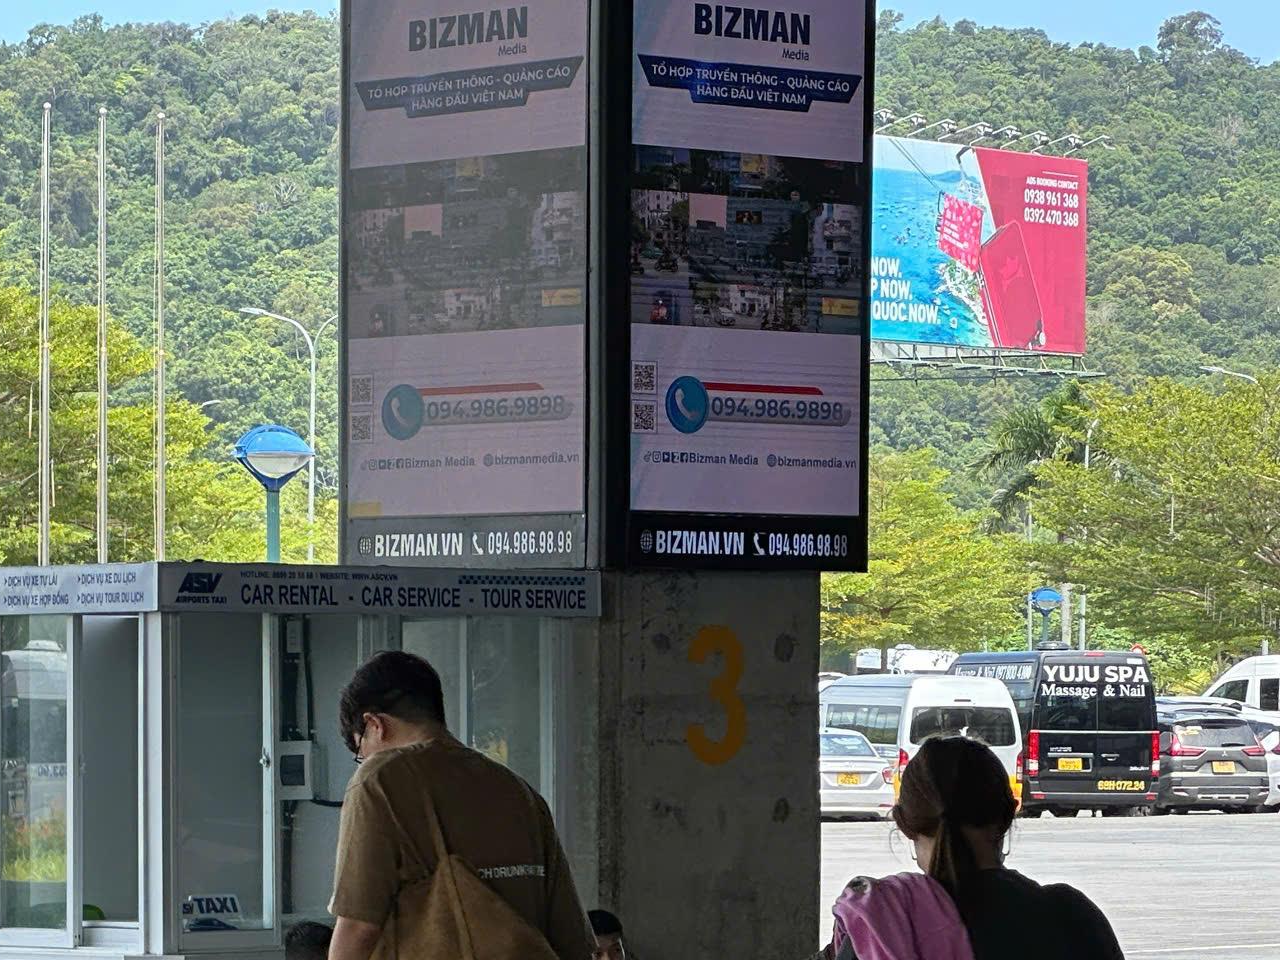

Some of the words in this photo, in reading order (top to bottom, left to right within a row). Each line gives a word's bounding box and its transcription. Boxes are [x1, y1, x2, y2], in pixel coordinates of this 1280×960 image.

[409, 6, 528, 51] BIZMAN
[694, 3, 811, 45] BIZMAN
[498, 44, 527, 56] Media
[782, 48, 810, 61] Media
[547, 65, 570, 79] CÁO
[740, 71, 778, 86] THÔNG
[828, 78, 850, 93] CÁO
[498, 88, 524, 101] NAM
[782, 91, 806, 106] NAM
[1024, 188, 1045, 205] 0938
[1046, 190, 1062, 206] 961
[1063, 192, 1079, 209] 368
[1024, 206, 1045, 223] 0392
[1045, 209, 1062, 226] 470
[1063, 211, 1079, 228] 368
[880, 279, 913, 301] NOW.
[908, 303, 941, 324] NOW.
[427, 395, 564, 420] 094.986.9898
[711, 396, 844, 421] 094.986.9898
[405, 458, 442, 469] Bizman
[445, 455, 475, 469] Media
[495, 452, 580, 467] bizmanmedia.vn
[689, 453, 726, 465] Bizman
[729, 454, 759, 466] Media
[778, 456, 857, 469] bizmanmedia.vn
[374, 533, 463, 557] BIZMAN.VN
[488, 530, 572, 555] 094.986.98.98
[656, 530, 745, 556] BIZMAN.VN
[769, 532, 848, 557] 094.986.98.98
[241, 584, 274, 606] CAR
[279, 584, 339, 606] RENTAL
[361, 586, 393, 607] CAR
[397, 587, 461, 608] SERVICE
[481, 588, 520, 609] TOUR
[525, 588, 586, 610] SERVICE
[1043, 665, 1100, 683] YUJU
[1105, 665, 1149, 683] SPA
[686, 623, 747, 766] 3
[1042, 684, 1097, 698] Massage
[1103, 684, 1116, 697] &
[1119, 684, 1145, 697] Nail
[193, 897, 239, 914] TAXI
